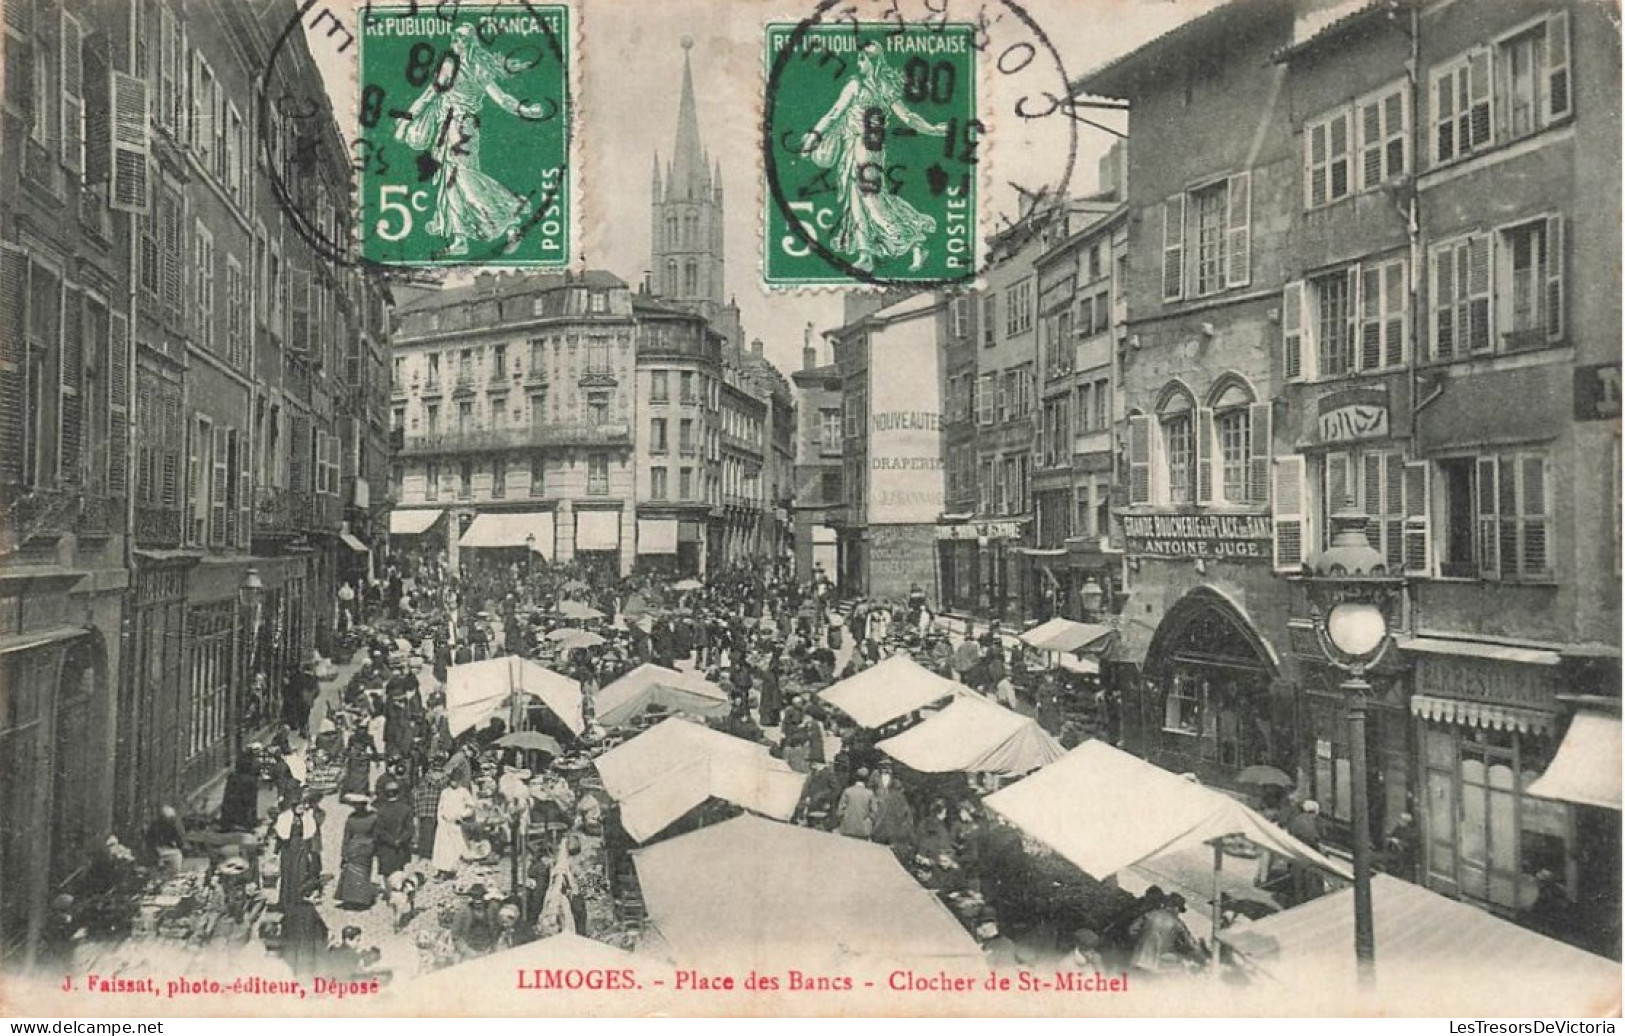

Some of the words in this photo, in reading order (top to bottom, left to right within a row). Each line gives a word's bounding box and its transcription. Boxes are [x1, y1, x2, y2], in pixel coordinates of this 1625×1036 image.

[774, 34, 858, 56] REUBLIQUE
[886, 34, 966, 55] FRANÇAISE
[542, 167, 560, 250] POSTES
[946, 185, 967, 269] POSTES
[1145, 541, 1208, 555] ANTOINE
[1216, 542, 1258, 556] JUGE
